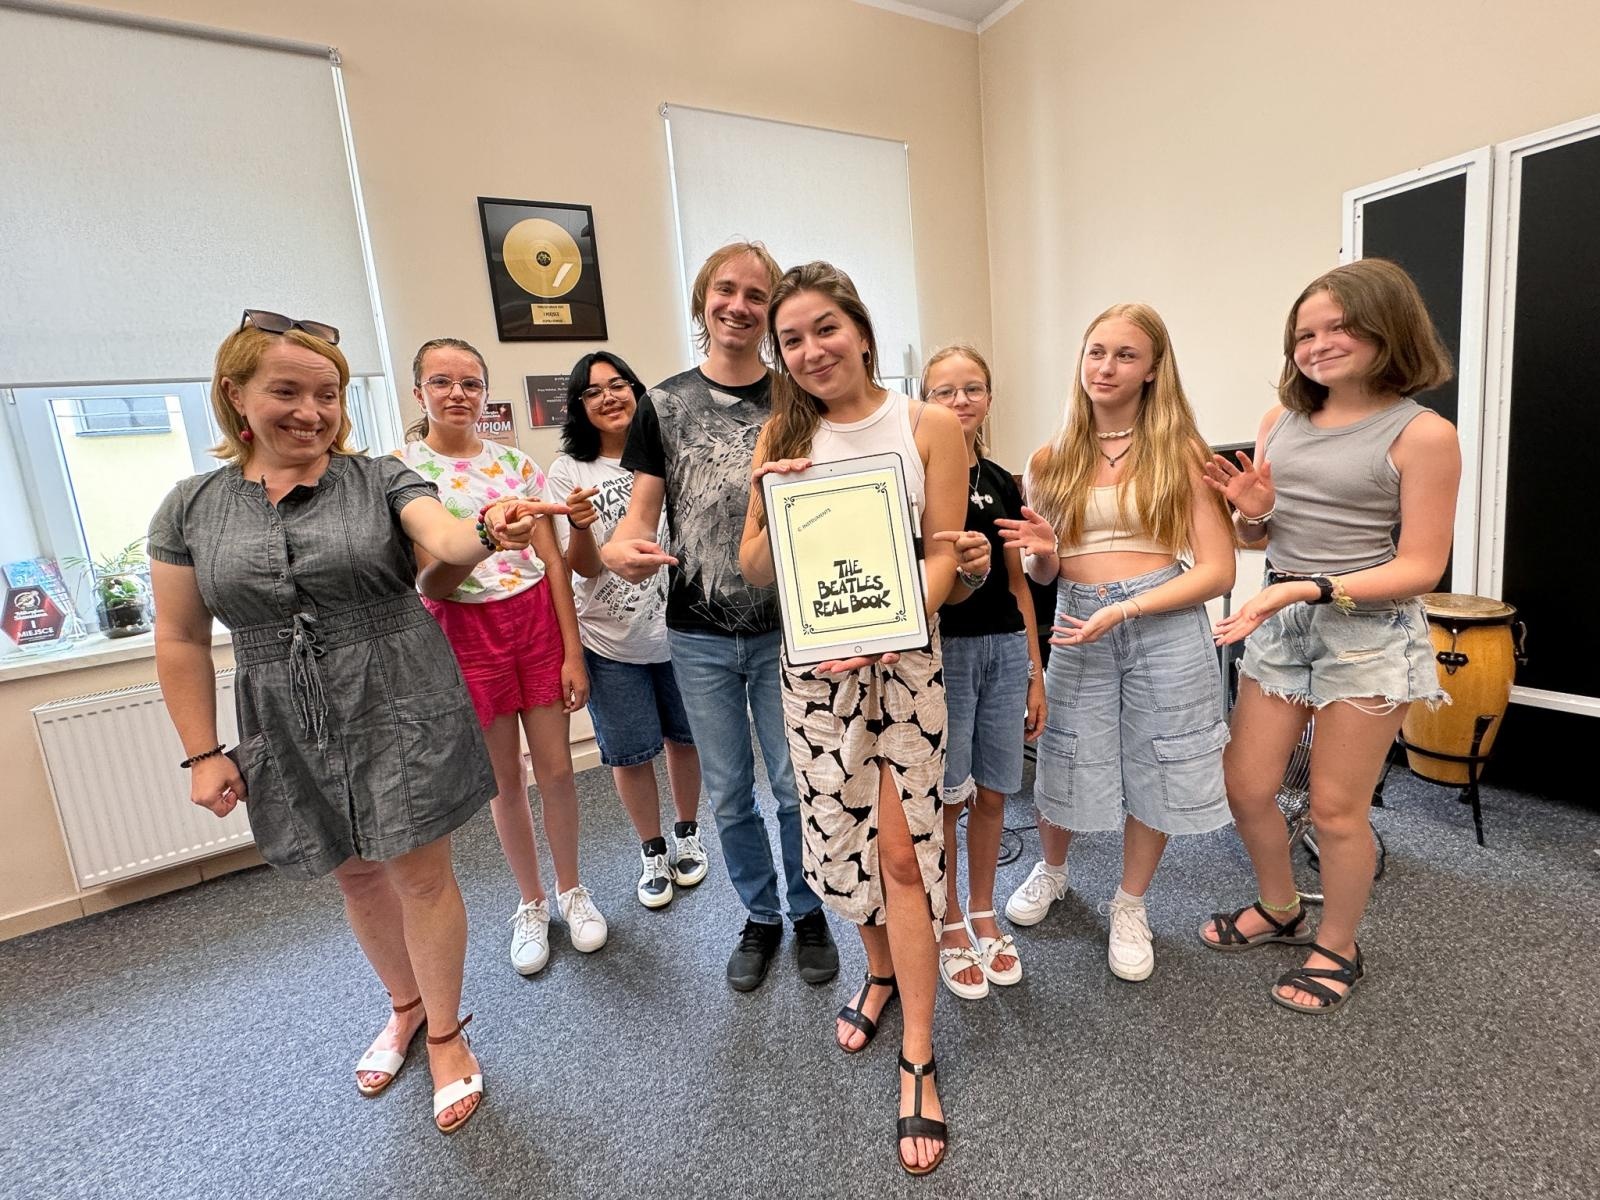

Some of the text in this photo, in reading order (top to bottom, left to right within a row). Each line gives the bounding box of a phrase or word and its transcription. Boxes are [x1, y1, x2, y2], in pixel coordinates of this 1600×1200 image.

[475, 420, 511, 435] YPLOM
[802, 508, 831, 529] INSTRUMENTS
[834, 559, 863, 579] THE
[594, 577, 616, 601] CONTEST
[817, 575, 883, 600] BEATLES
[812, 589, 892, 618] REAL BOOK
[17, 627, 54, 637] MIEJSCE
